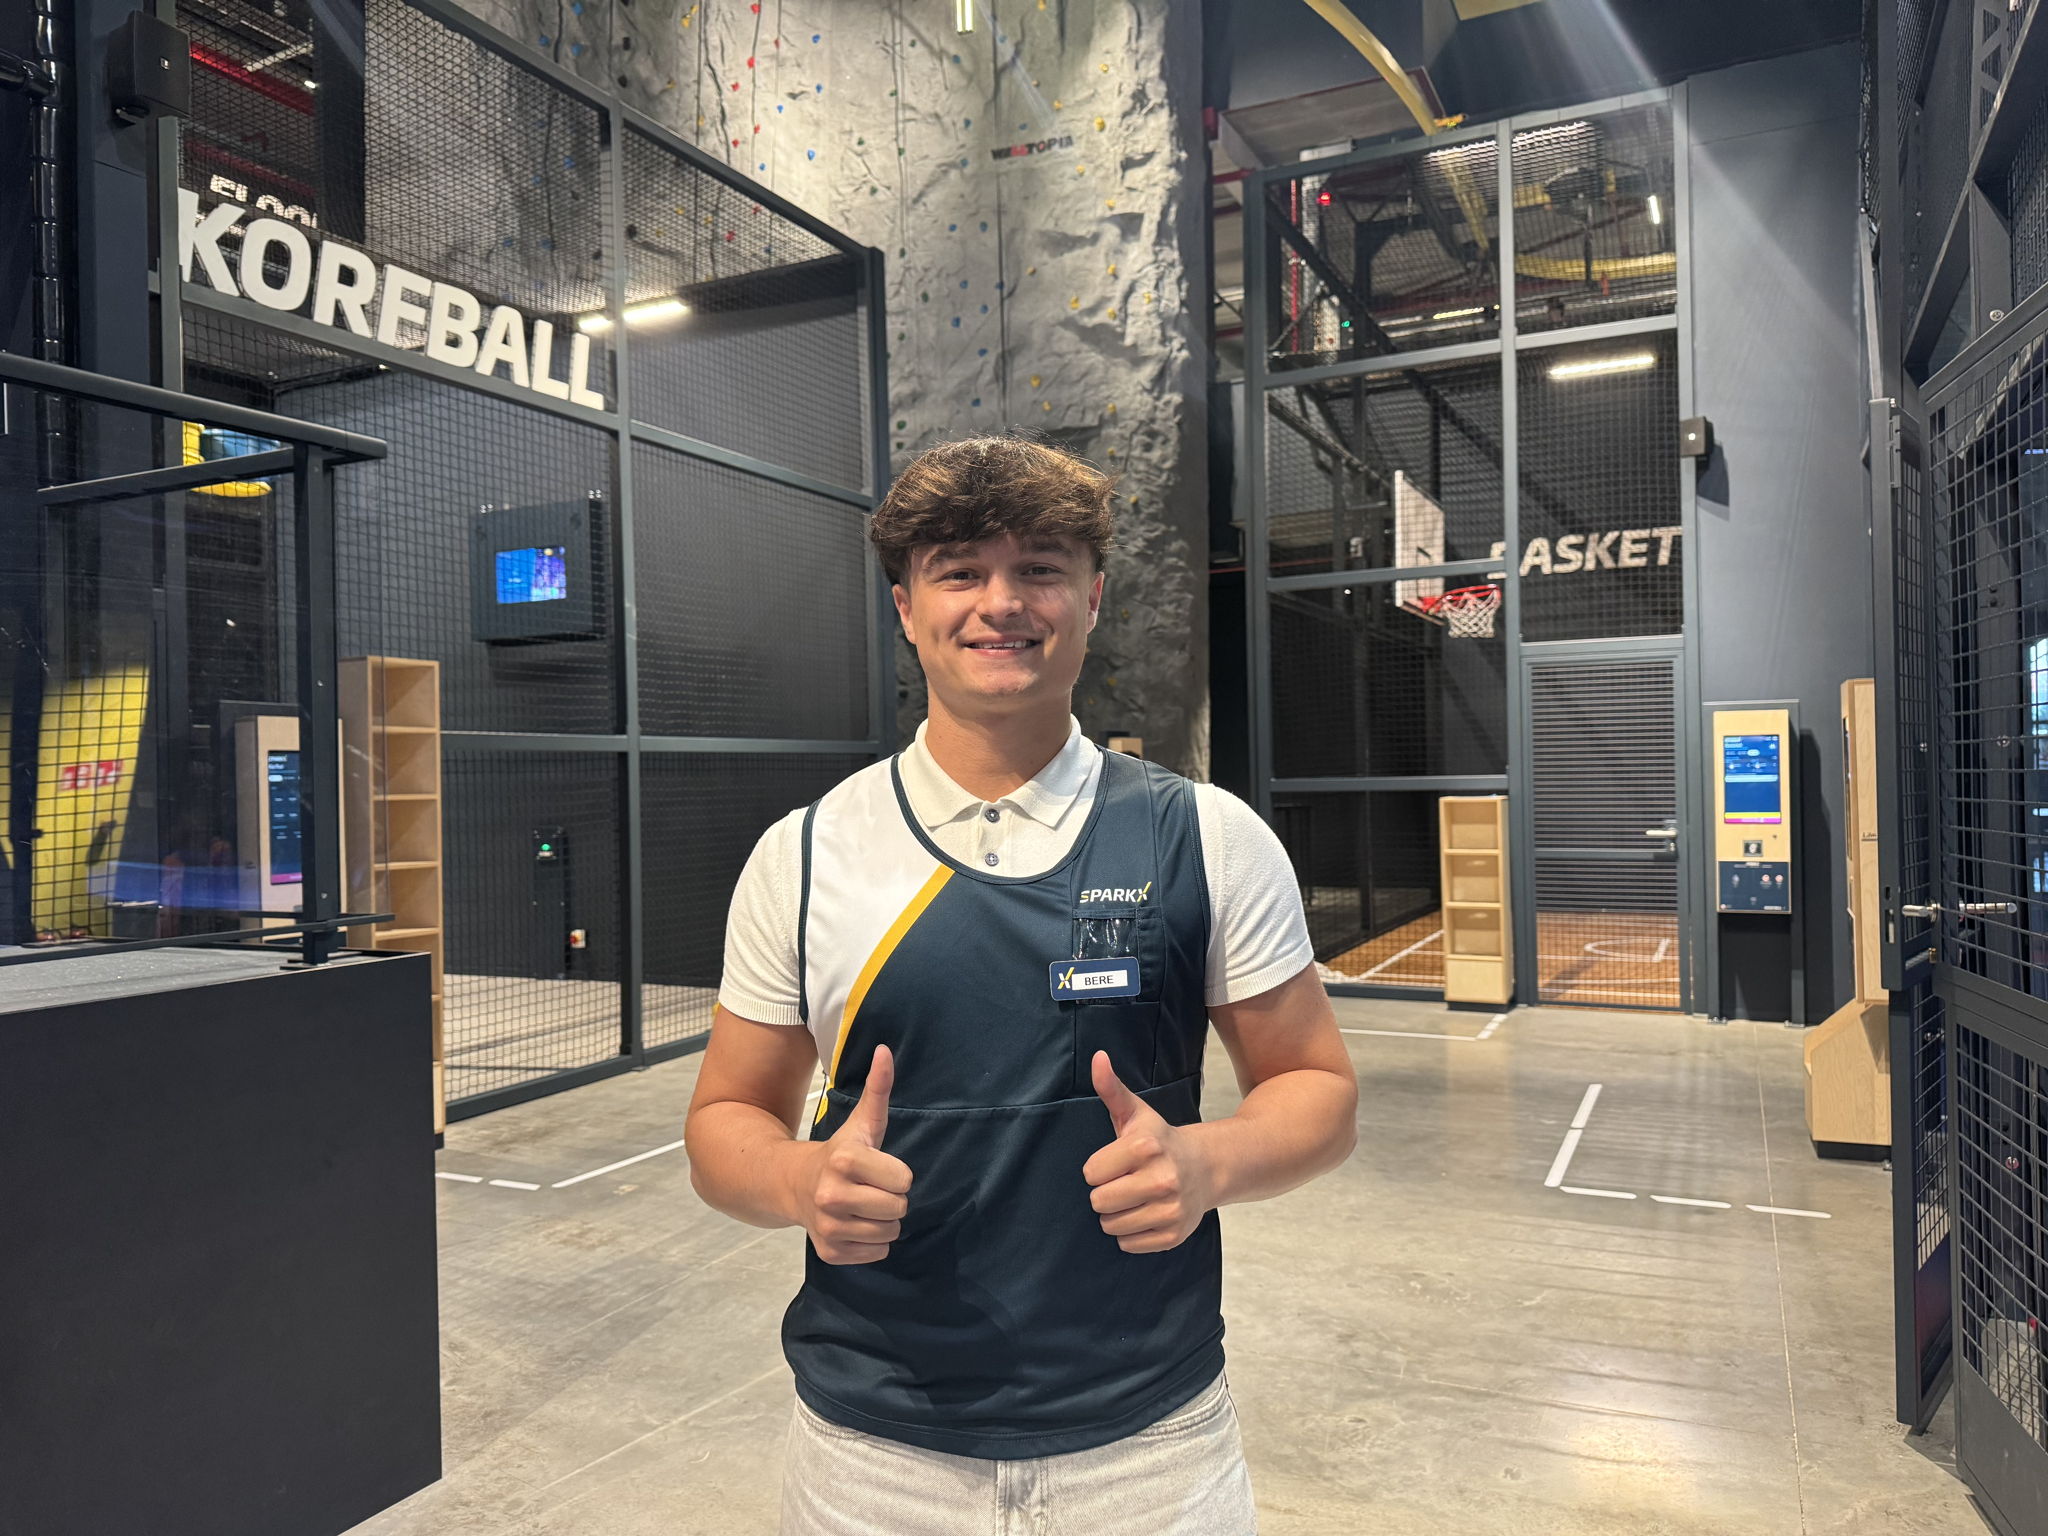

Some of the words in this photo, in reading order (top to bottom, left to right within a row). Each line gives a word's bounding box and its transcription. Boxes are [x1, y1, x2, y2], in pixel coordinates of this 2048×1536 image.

[178, 187, 605, 411] KORFBALL
[1079, 880, 1152, 904] SPARKX
[1084, 974, 1115, 986] BERE
